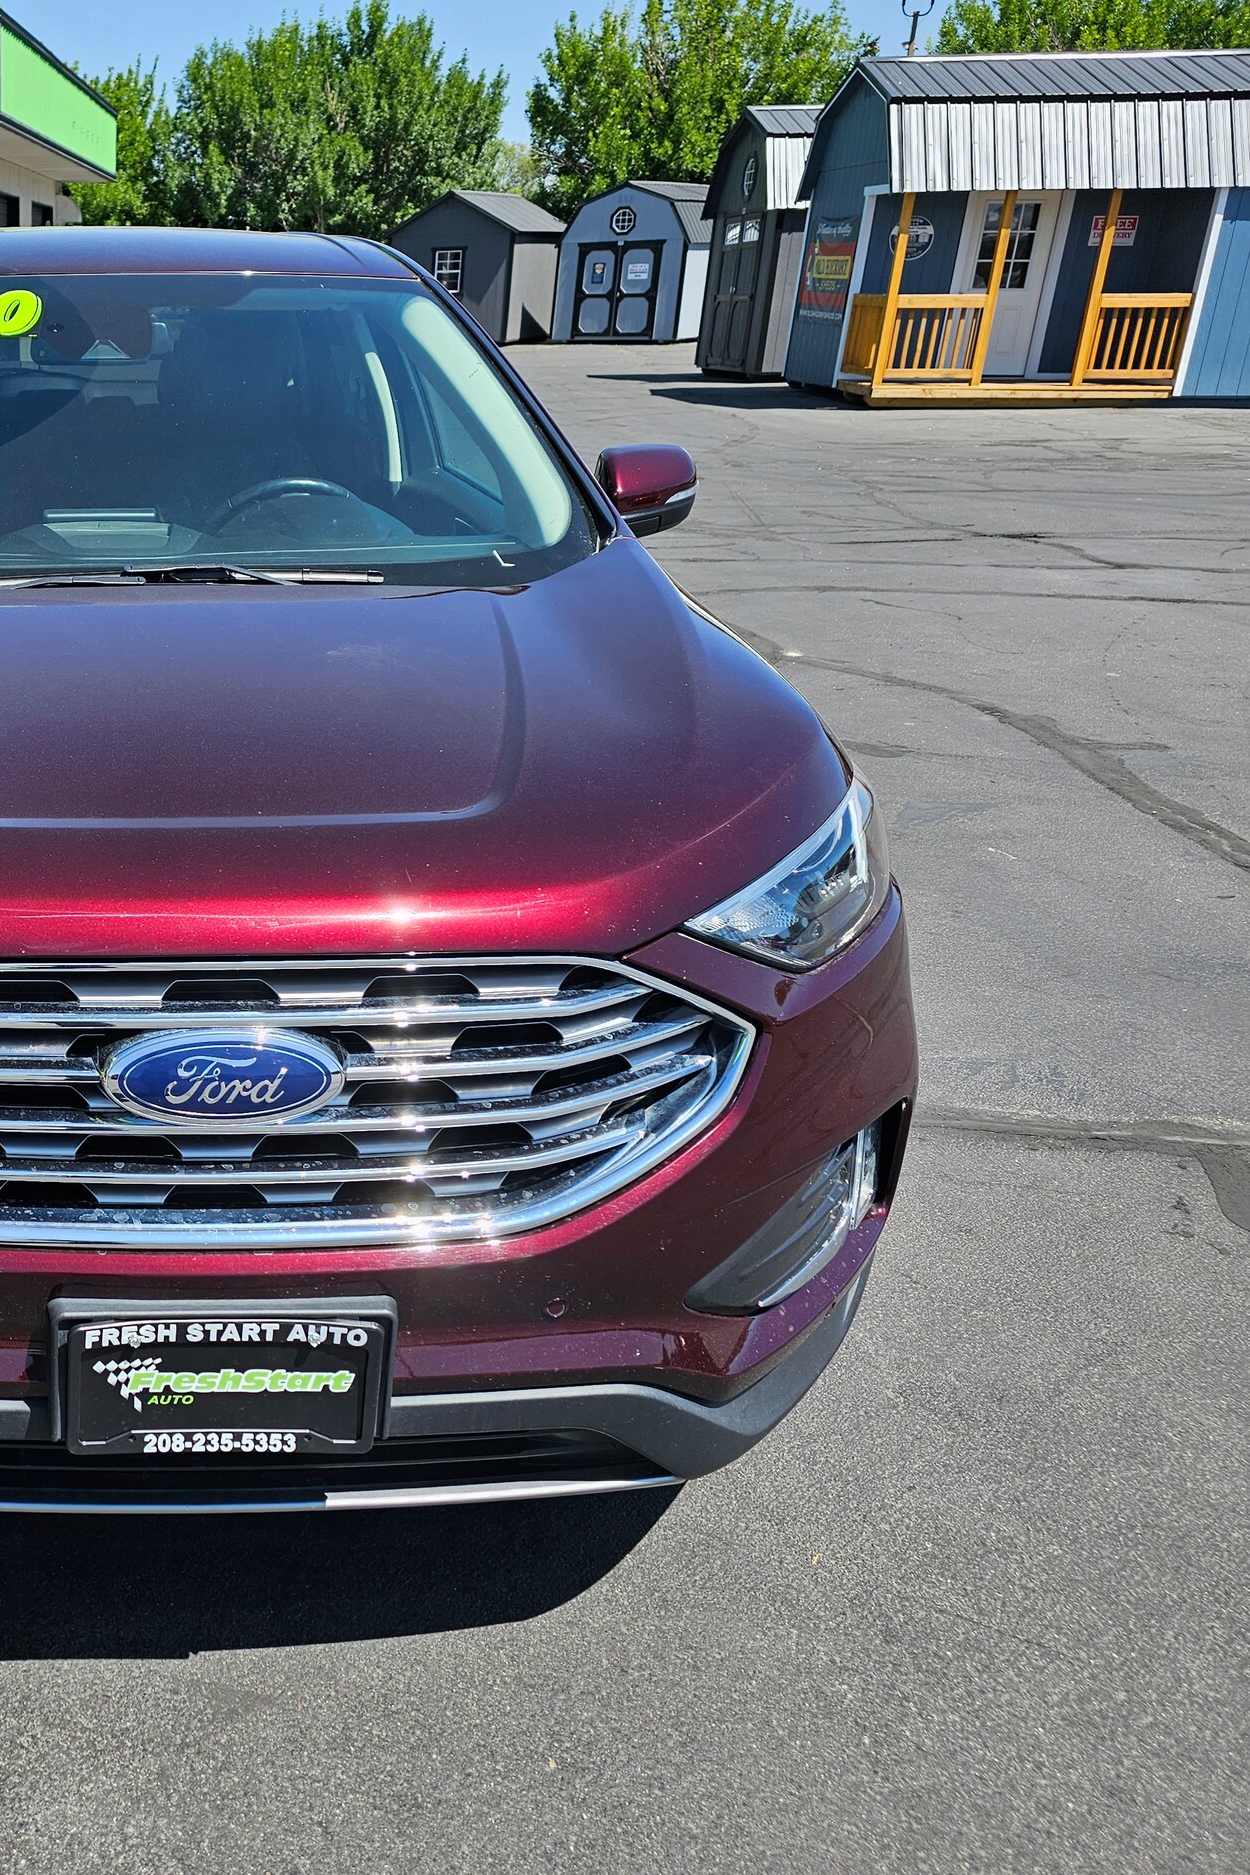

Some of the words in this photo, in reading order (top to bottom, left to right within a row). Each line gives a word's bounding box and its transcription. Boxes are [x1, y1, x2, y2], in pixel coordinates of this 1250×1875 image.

[1096, 218, 1134, 229] FEE
[164, 1055, 289, 1105] Ford
[84, 1323, 177, 1349] FRESH
[186, 1322, 280, 1342] START
[286, 1323, 369, 1348] AUTO
[127, 1368, 355, 1393] FreshStart
[147, 1394, 195, 1406] AUTO
[142, 1433, 297, 1453] 208-235-5353
